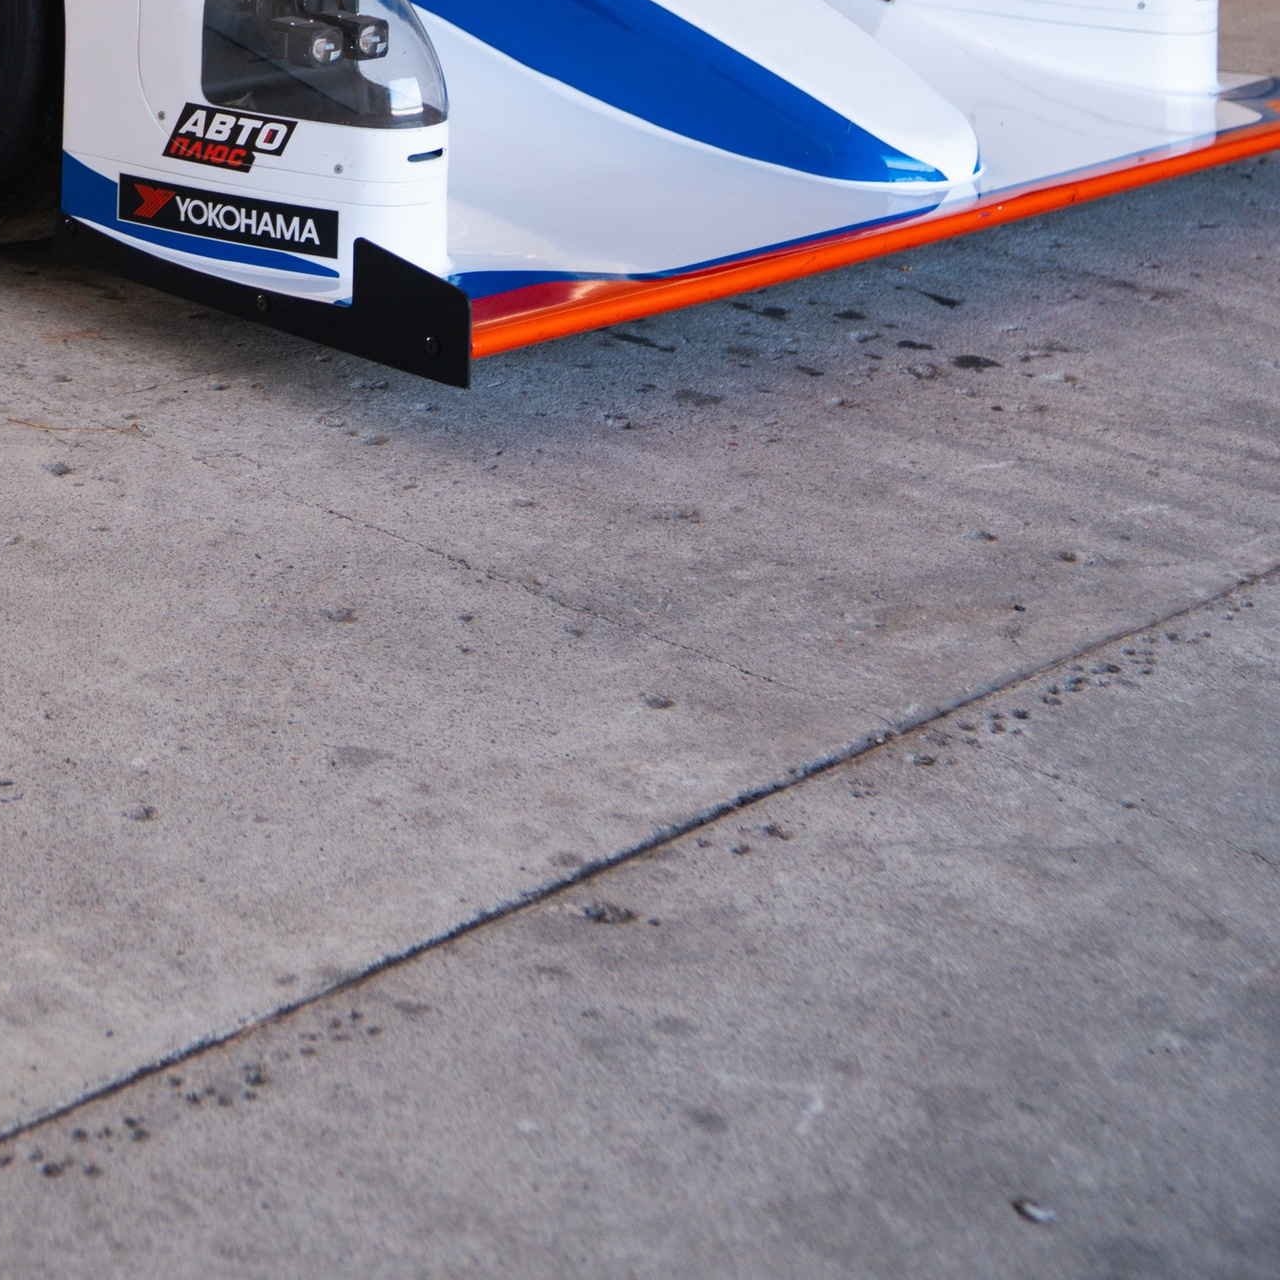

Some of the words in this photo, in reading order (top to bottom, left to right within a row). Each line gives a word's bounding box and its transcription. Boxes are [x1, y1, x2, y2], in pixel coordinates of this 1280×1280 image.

[178, 109, 288, 151] АВТО
[170, 136, 247, 167] ПЛЮС
[175, 195, 321, 245] YOKOHAMA
